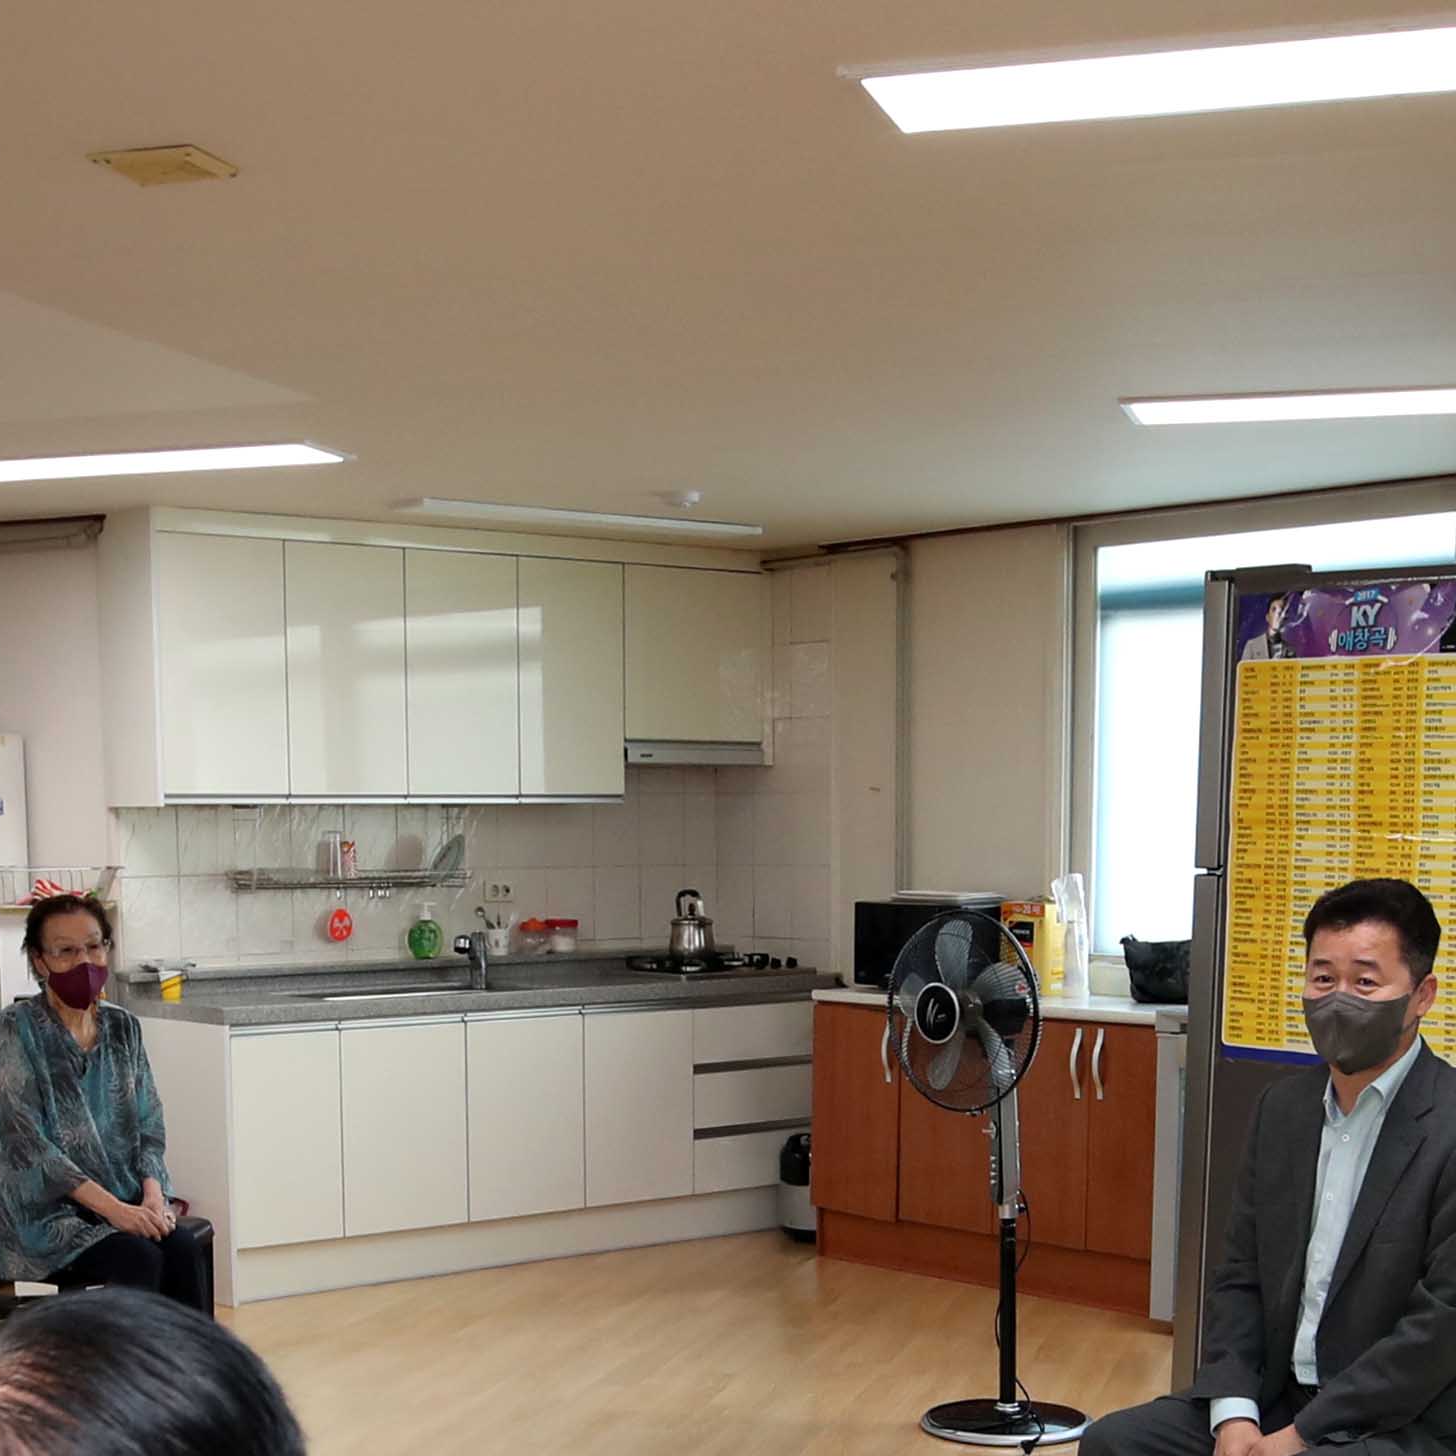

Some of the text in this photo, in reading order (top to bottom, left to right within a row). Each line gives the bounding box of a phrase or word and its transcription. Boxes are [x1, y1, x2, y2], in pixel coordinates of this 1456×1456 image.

[1357, 589, 1377, 601] 2017
[1350, 603, 1382, 628] KY
[1337, 627, 1388, 651] 애창곡
